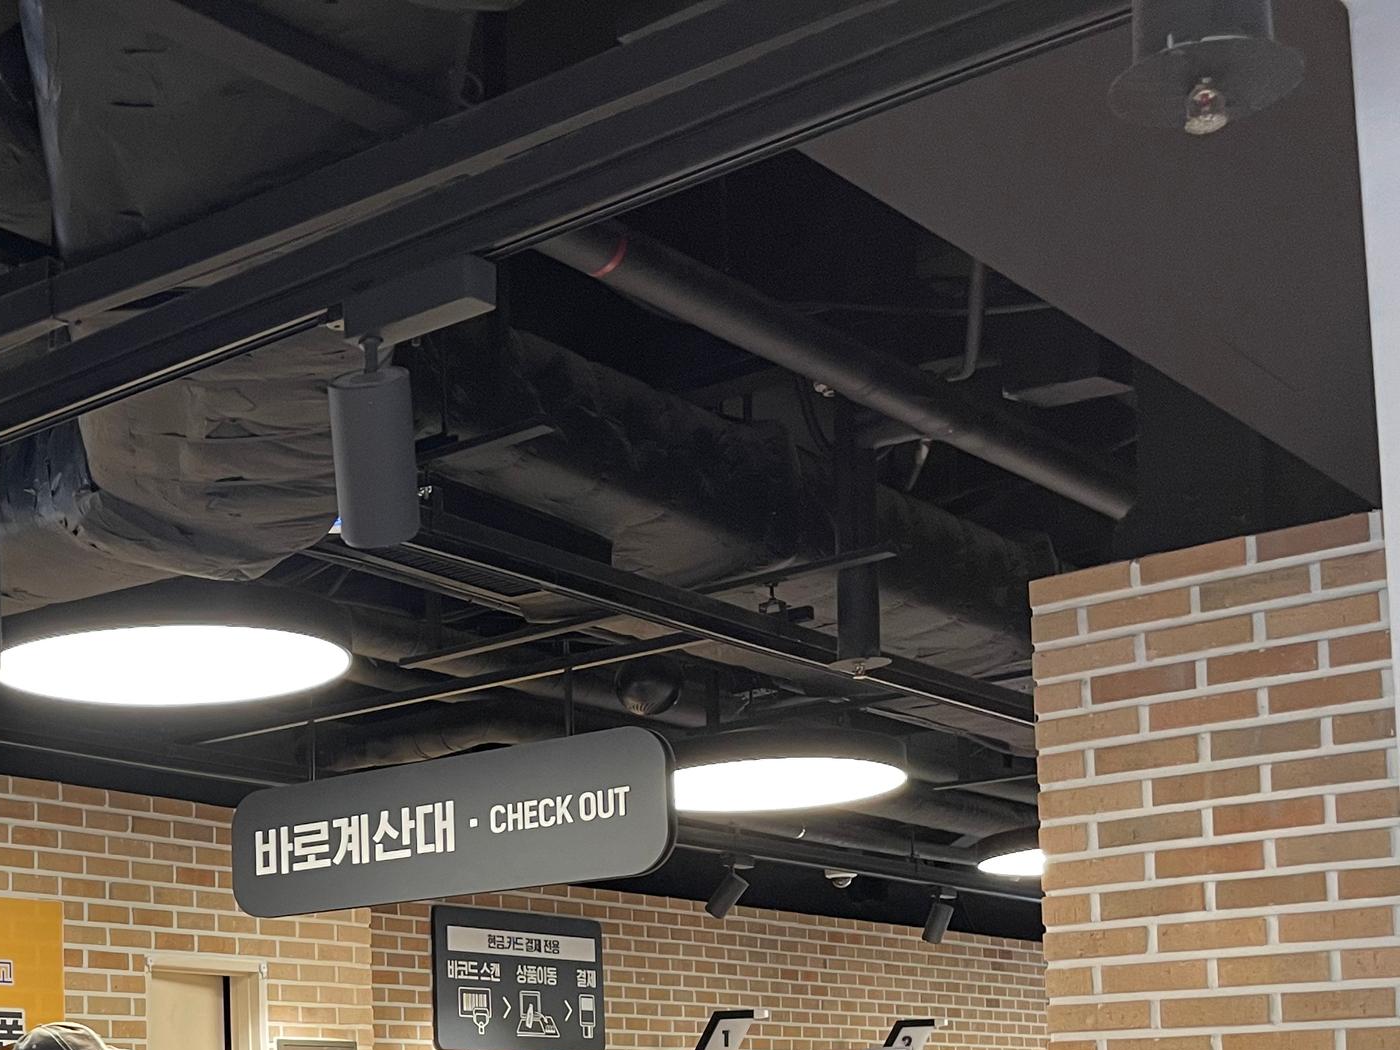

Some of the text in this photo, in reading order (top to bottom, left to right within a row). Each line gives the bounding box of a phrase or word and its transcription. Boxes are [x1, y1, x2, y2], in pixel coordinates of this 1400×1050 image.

[255, 785, 631, 876] 바로계산대 CHECK OUT
[516, 965, 558, 986] 상품이동
[576, 969, 597, 988] 결제
[722, 1030, 730, 1047] 1
